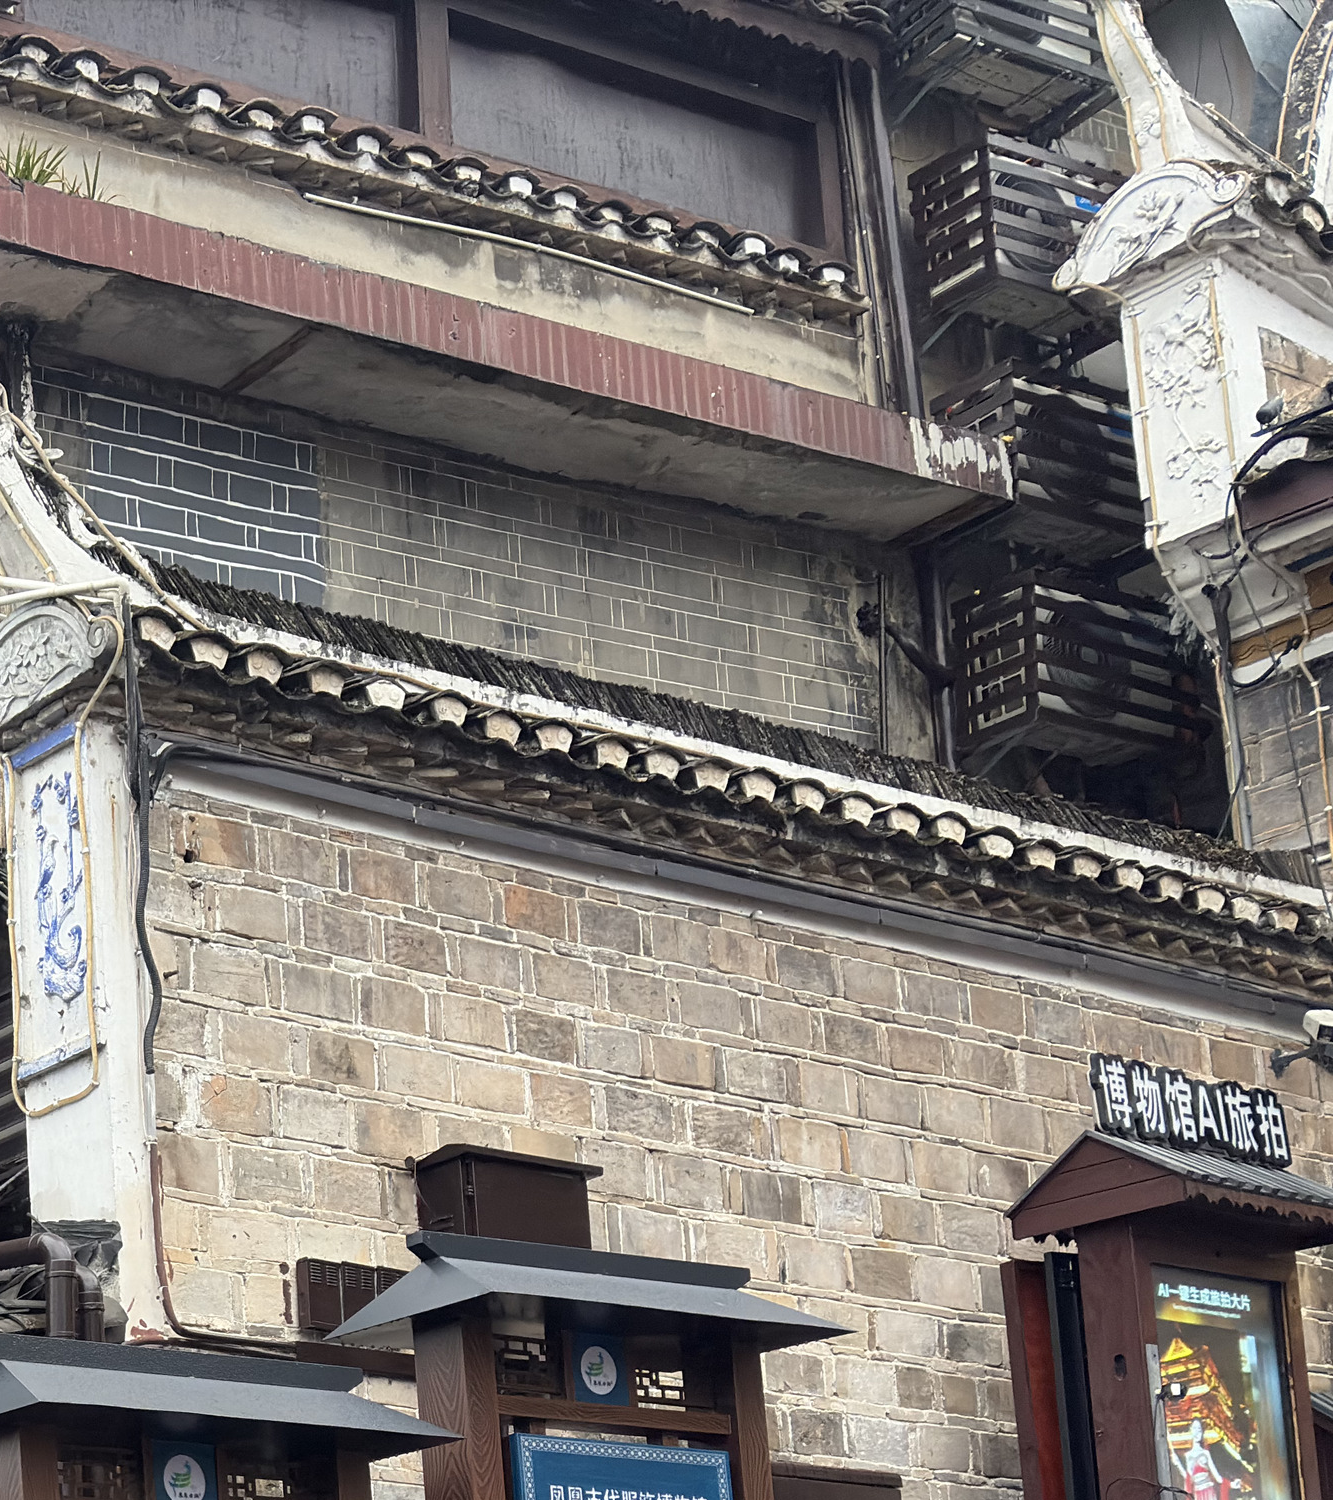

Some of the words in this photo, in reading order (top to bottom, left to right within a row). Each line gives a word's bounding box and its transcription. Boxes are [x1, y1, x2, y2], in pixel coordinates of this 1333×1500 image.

[1099, 1060, 1289, 1161] 博物馆AI旅拍
